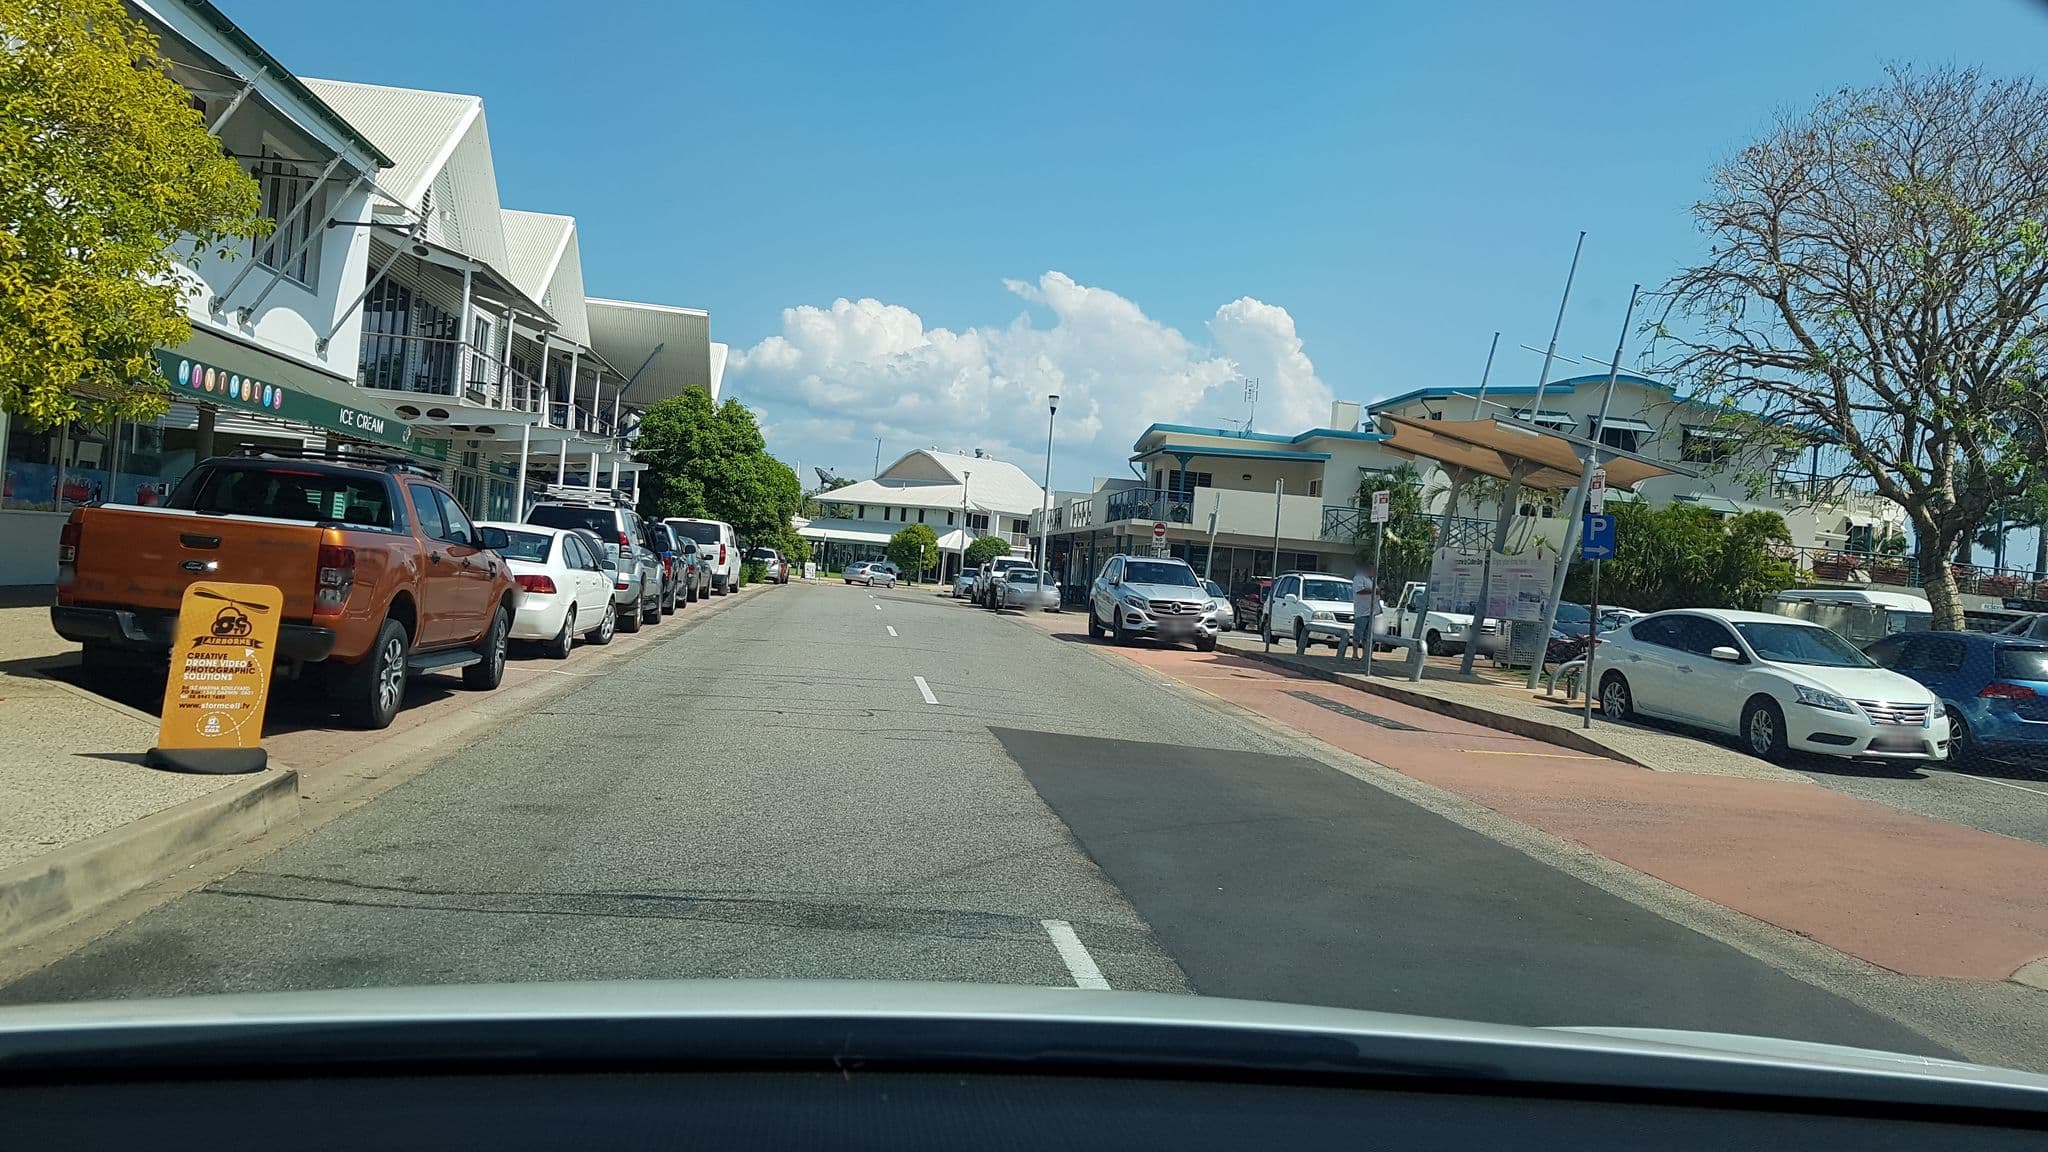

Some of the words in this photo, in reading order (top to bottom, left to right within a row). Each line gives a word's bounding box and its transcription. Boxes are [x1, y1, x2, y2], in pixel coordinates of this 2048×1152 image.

[340, 408, 354, 426] ICE
[357, 413, 384, 434] CREAM
[1590, 518, 1607, 541] P
[205, 637, 251, 646] AIRBORNE
[187, 652, 228, 660] CREATIVE
[185, 659, 217, 667] DRONE
[184, 666, 256, 675] PHOTOGRAPHIC
[183, 673, 233, 681] SOLUTIONS
[179, 702, 251, 710] www.stormcell.tv
